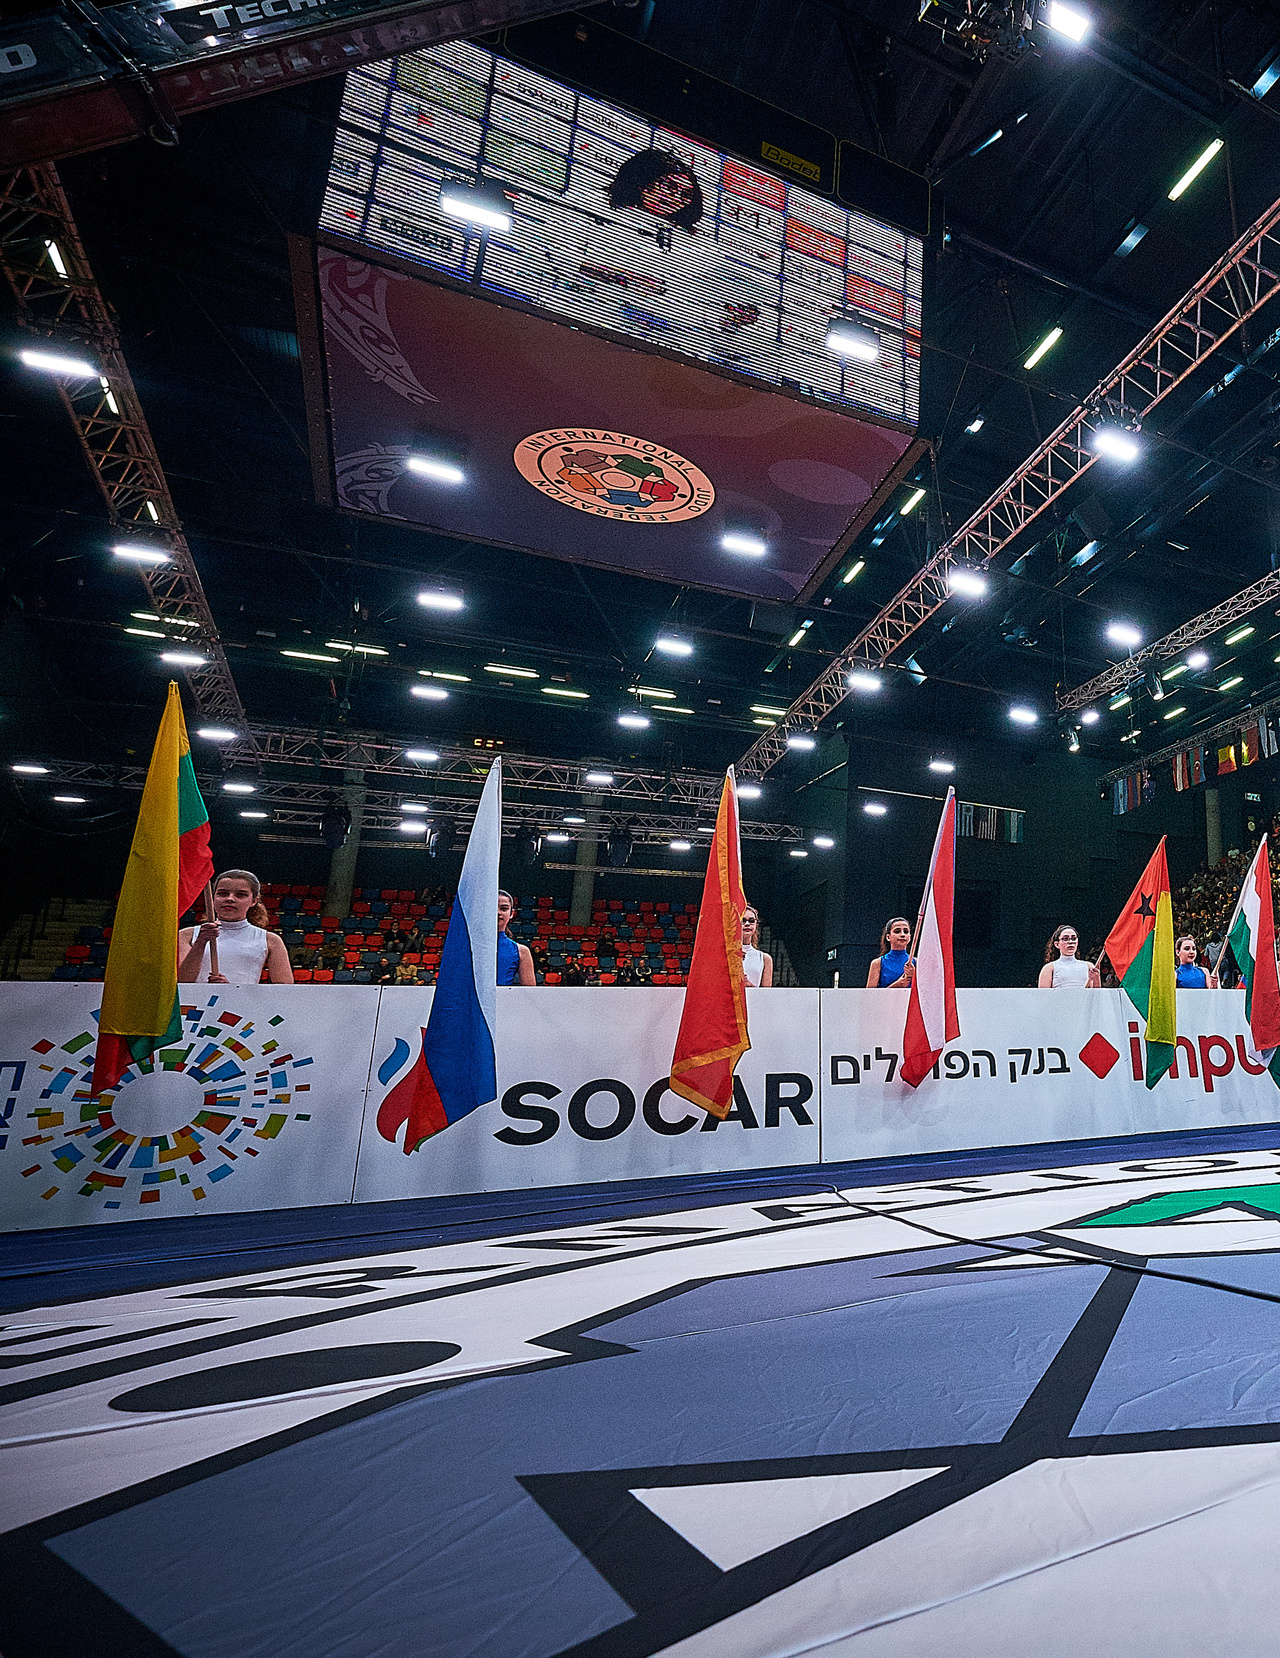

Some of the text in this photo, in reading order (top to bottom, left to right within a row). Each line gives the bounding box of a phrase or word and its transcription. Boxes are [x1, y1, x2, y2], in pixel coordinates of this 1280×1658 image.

[523, 430, 711, 513] INTERNATIONAL JUDO
[533, 478, 670, 522] FEDERATION
[830, 1046, 1071, 1086] בנק הפולים
[492, 1072, 815, 1147] SOCAR
